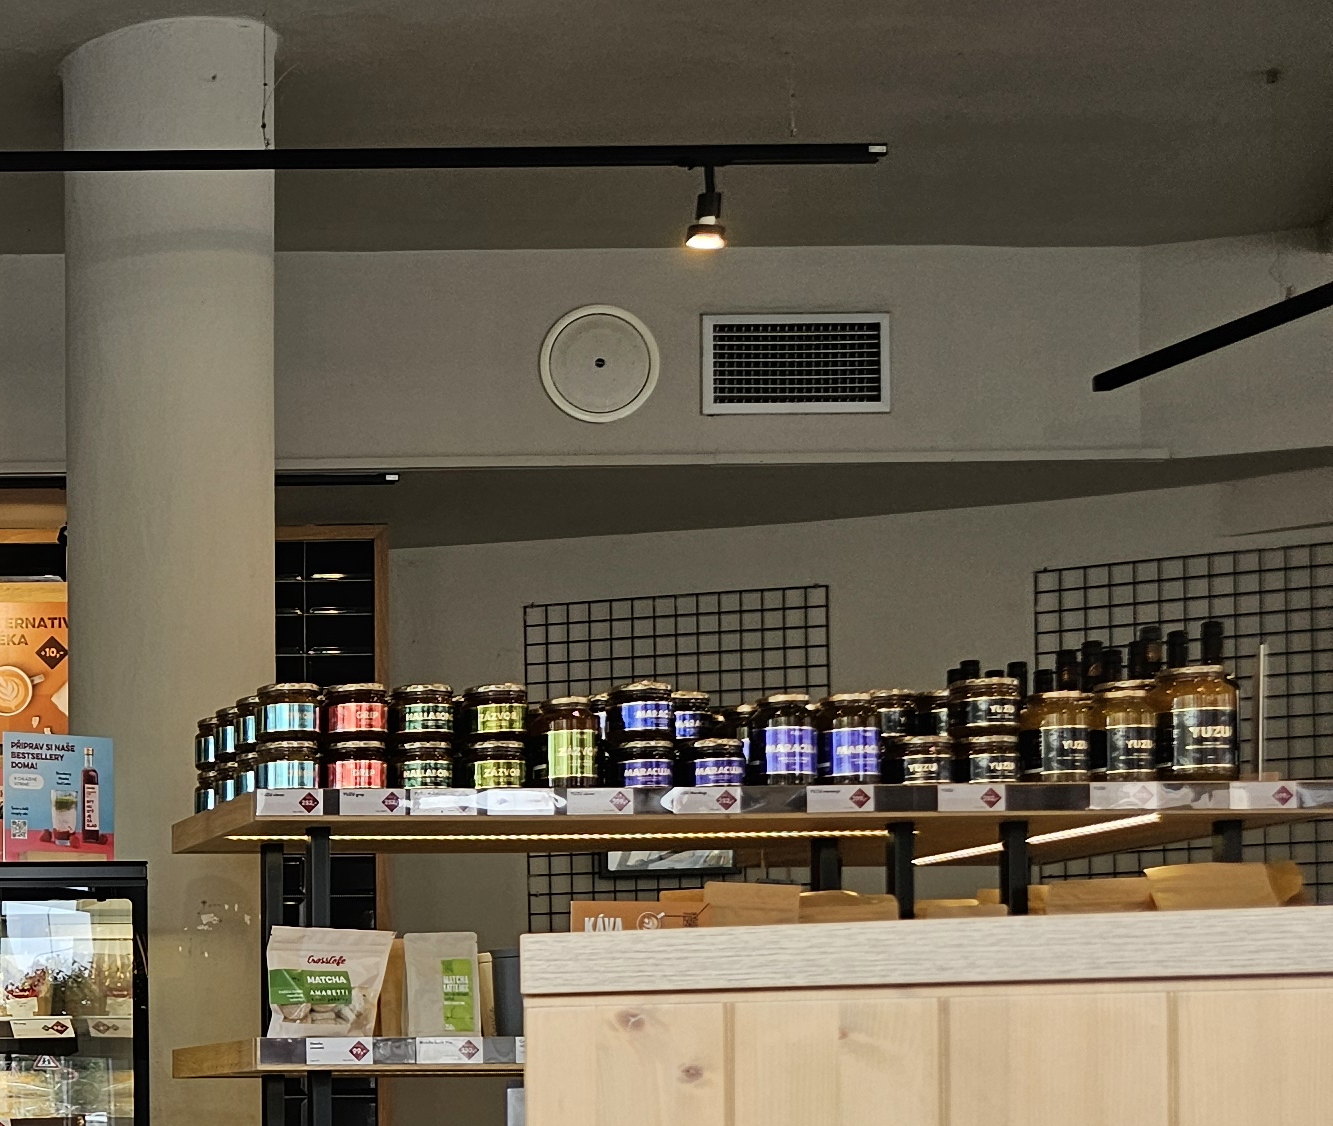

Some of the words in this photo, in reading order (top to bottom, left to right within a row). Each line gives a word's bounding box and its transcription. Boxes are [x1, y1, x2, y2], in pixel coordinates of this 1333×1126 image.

[990, 705, 1015, 713] YUZU
[1189, 726, 1231, 737] YUZU
[11, 742, 44, 750] PŘIPRAV
[55, 743, 75, 752] NAŠE
[11, 752, 64, 761] BESTSELLERY
[907, 763, 937, 771] YUZU
[585, 914, 622, 932] KÁVA
[307, 976, 347, 984] MATCHA
